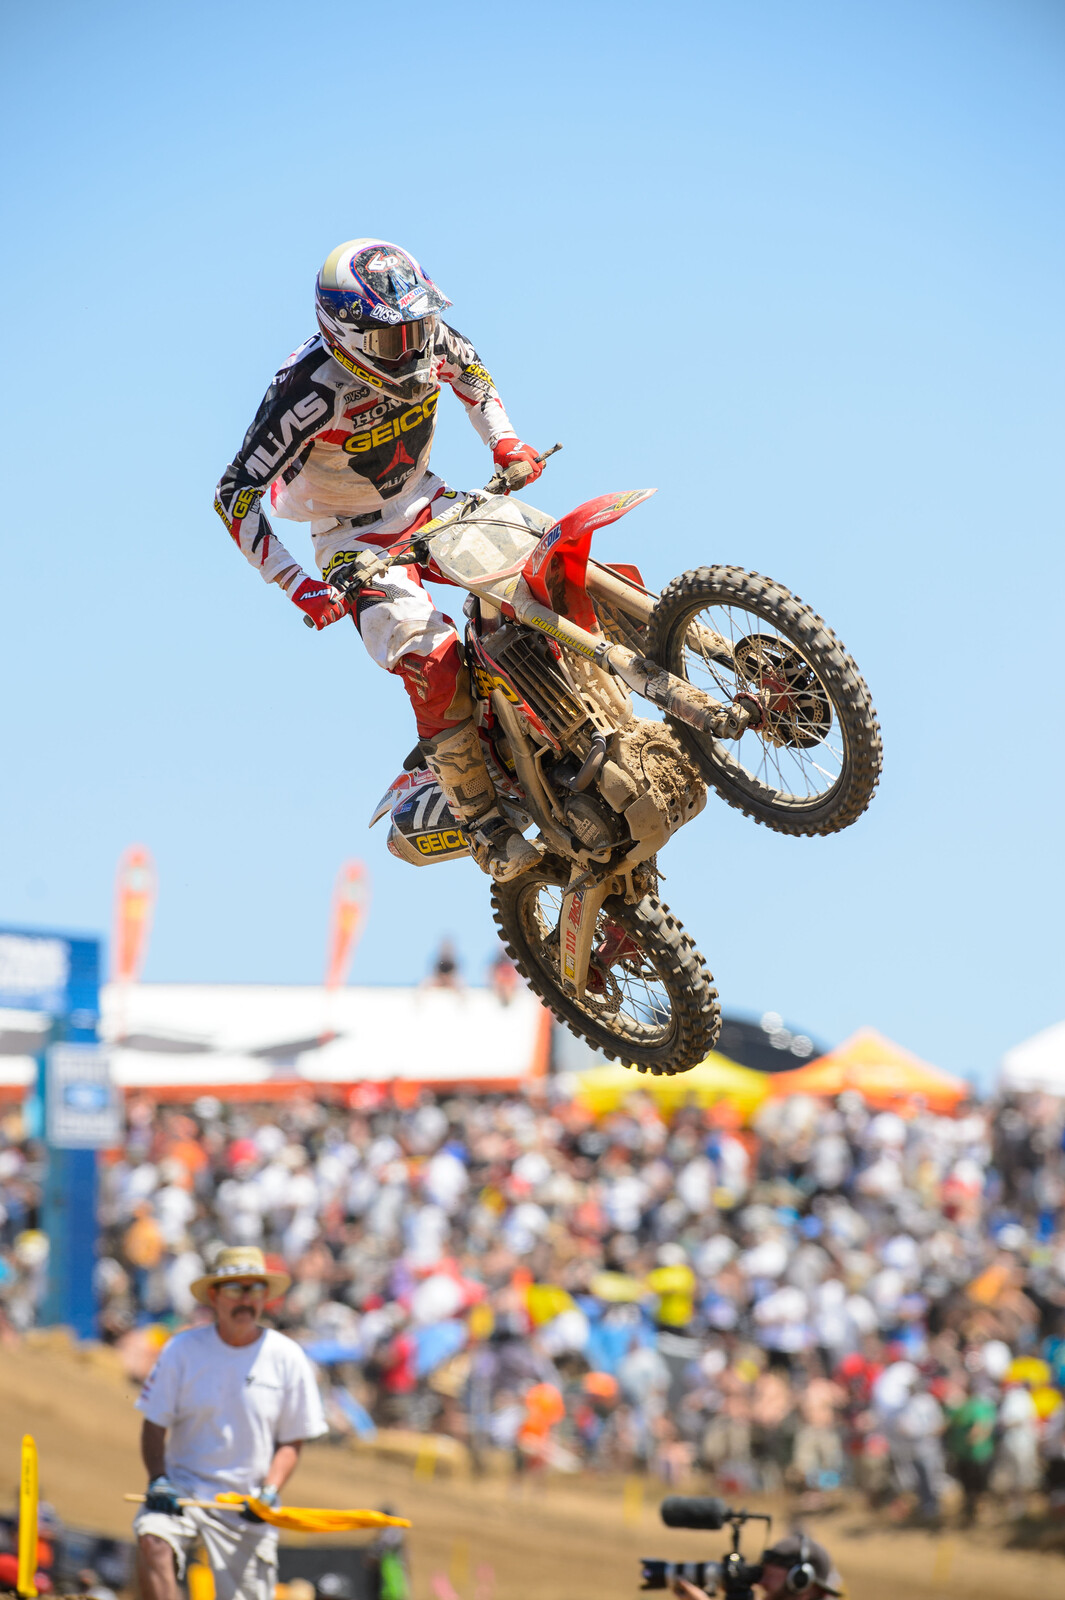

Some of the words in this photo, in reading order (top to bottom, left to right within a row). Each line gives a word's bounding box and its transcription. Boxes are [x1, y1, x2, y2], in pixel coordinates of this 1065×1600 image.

[367, 252, 399, 272] 6D
[400, 287, 425, 307] AMSOIL
[372, 304, 392, 320] DVS
[333, 348, 383, 388] GEICO
[344, 389, 361, 404] DVS
[344, 391, 440, 453] GEICO
[353, 398, 405, 428] HON
[568, 890, 584, 930] AMSO
